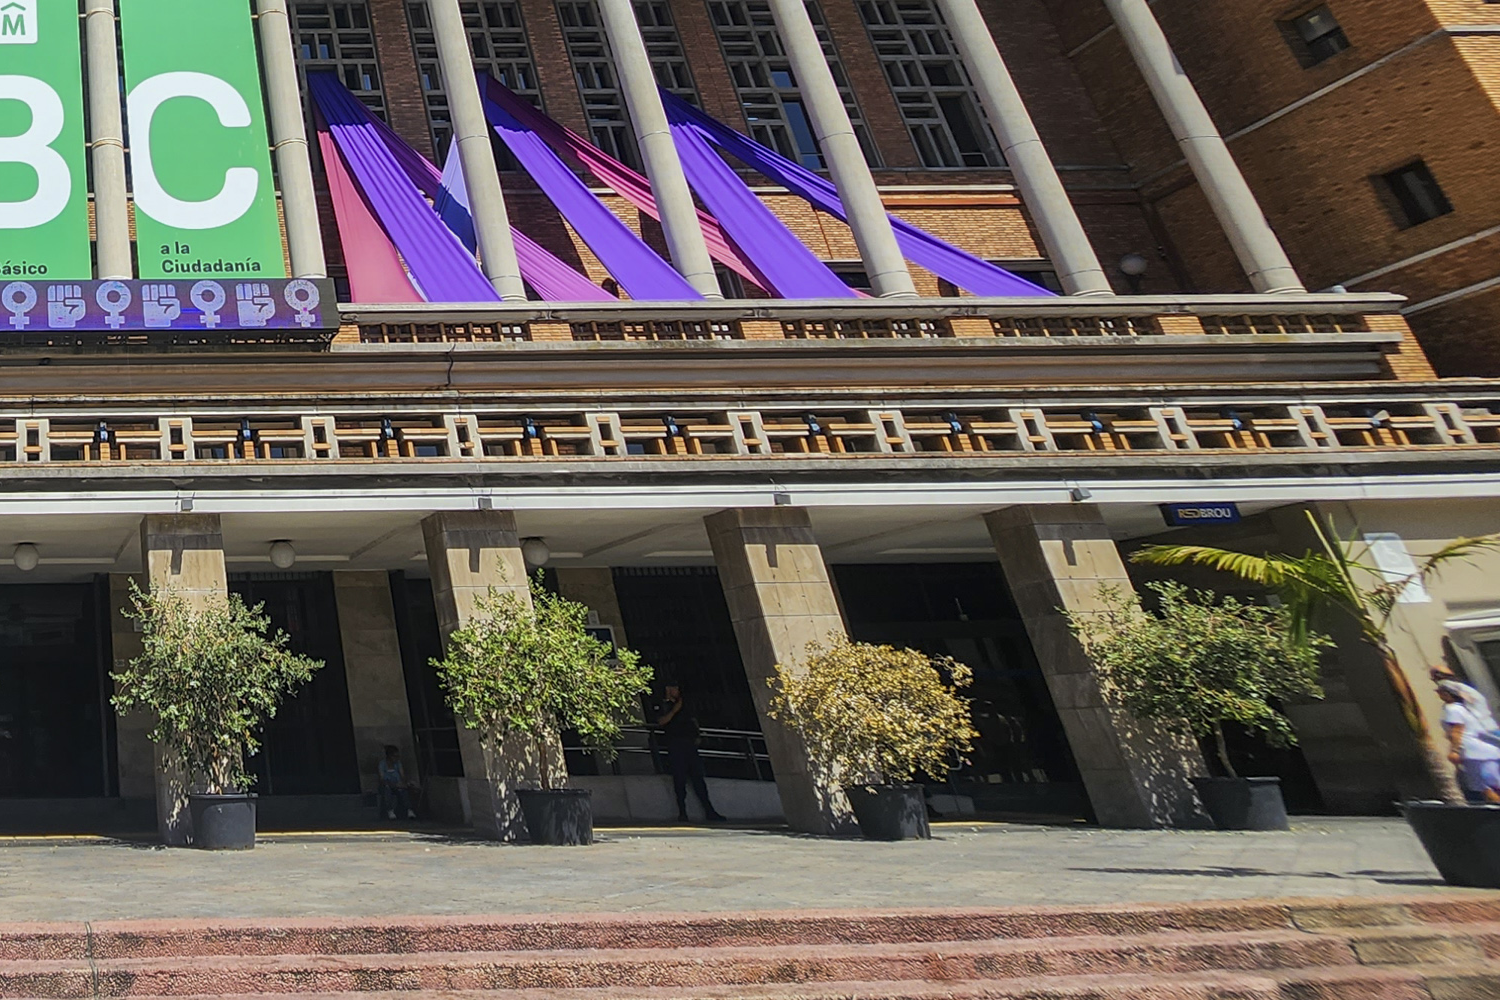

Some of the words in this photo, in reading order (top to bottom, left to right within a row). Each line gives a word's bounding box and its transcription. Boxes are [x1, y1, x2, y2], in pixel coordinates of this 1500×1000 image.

[2, 14, 26, 36] M
[127, 71, 259, 230] C
[160, 244, 170, 255] a
[174, 241, 191, 255] la
[161, 257, 262, 274] Ciudadanía
